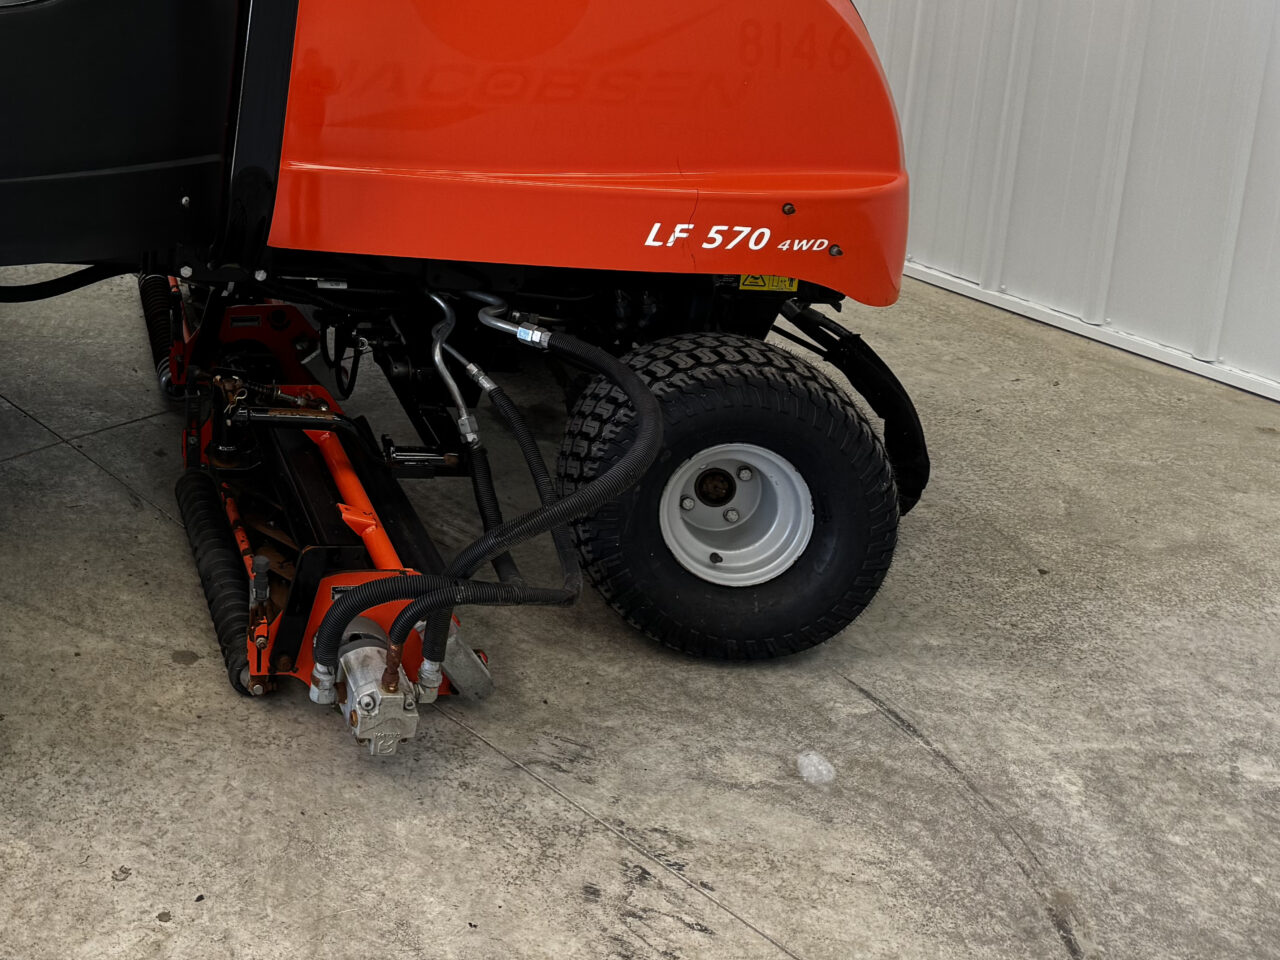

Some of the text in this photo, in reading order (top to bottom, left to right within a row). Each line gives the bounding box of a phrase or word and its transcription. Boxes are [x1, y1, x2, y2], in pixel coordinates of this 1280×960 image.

[644, 222, 829, 252] LF 570 4WD
